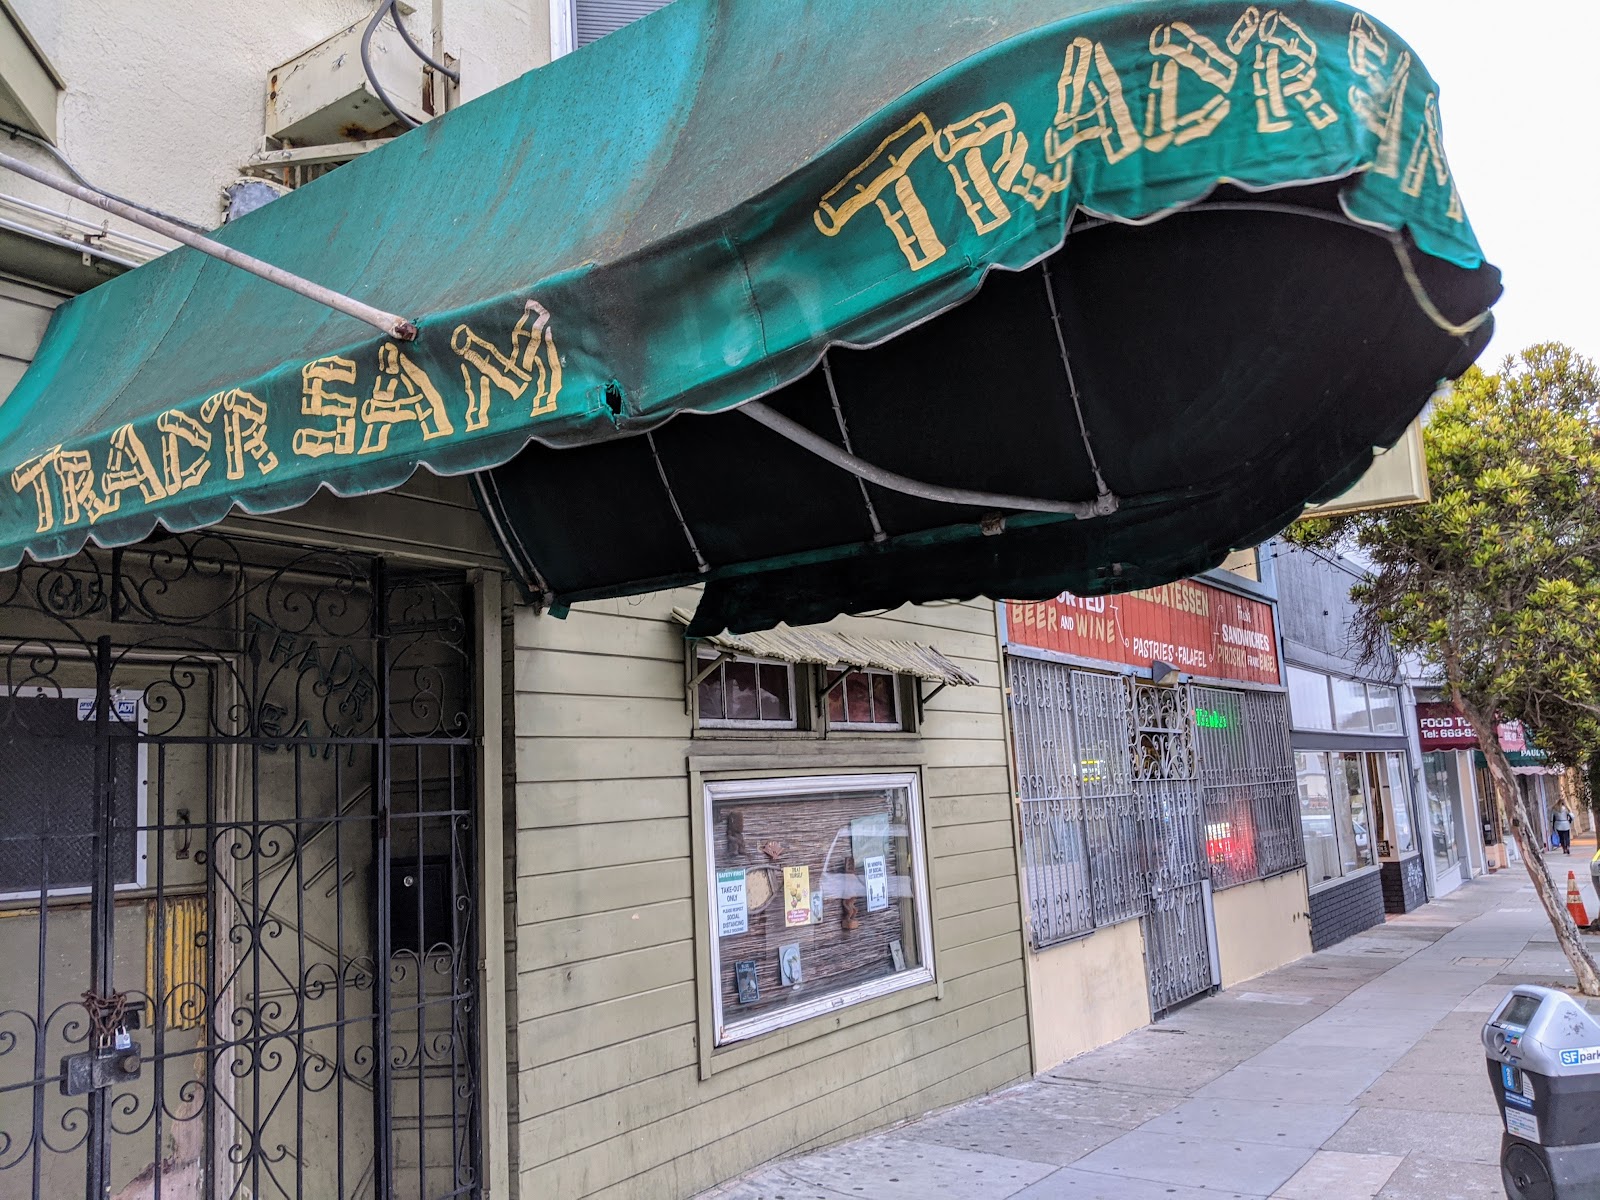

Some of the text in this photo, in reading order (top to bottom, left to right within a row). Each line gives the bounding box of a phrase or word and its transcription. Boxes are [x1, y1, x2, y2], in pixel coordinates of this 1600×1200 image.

[292, 299, 563, 458] SAM
[1012, 599, 1115, 644] BEER AND WINE
[1222, 623, 1270, 652] SANDWICHES
[1133, 637, 1207, 668] PASTRIES FALAFEL
[119, 702, 134, 714] ADT
[1421, 718, 1453, 728] FOOD
[1422, 729, 1438, 739] Tel:
[718, 871, 733, 879] SAFETY
[721, 885, 742, 894] TAKE-OUT
